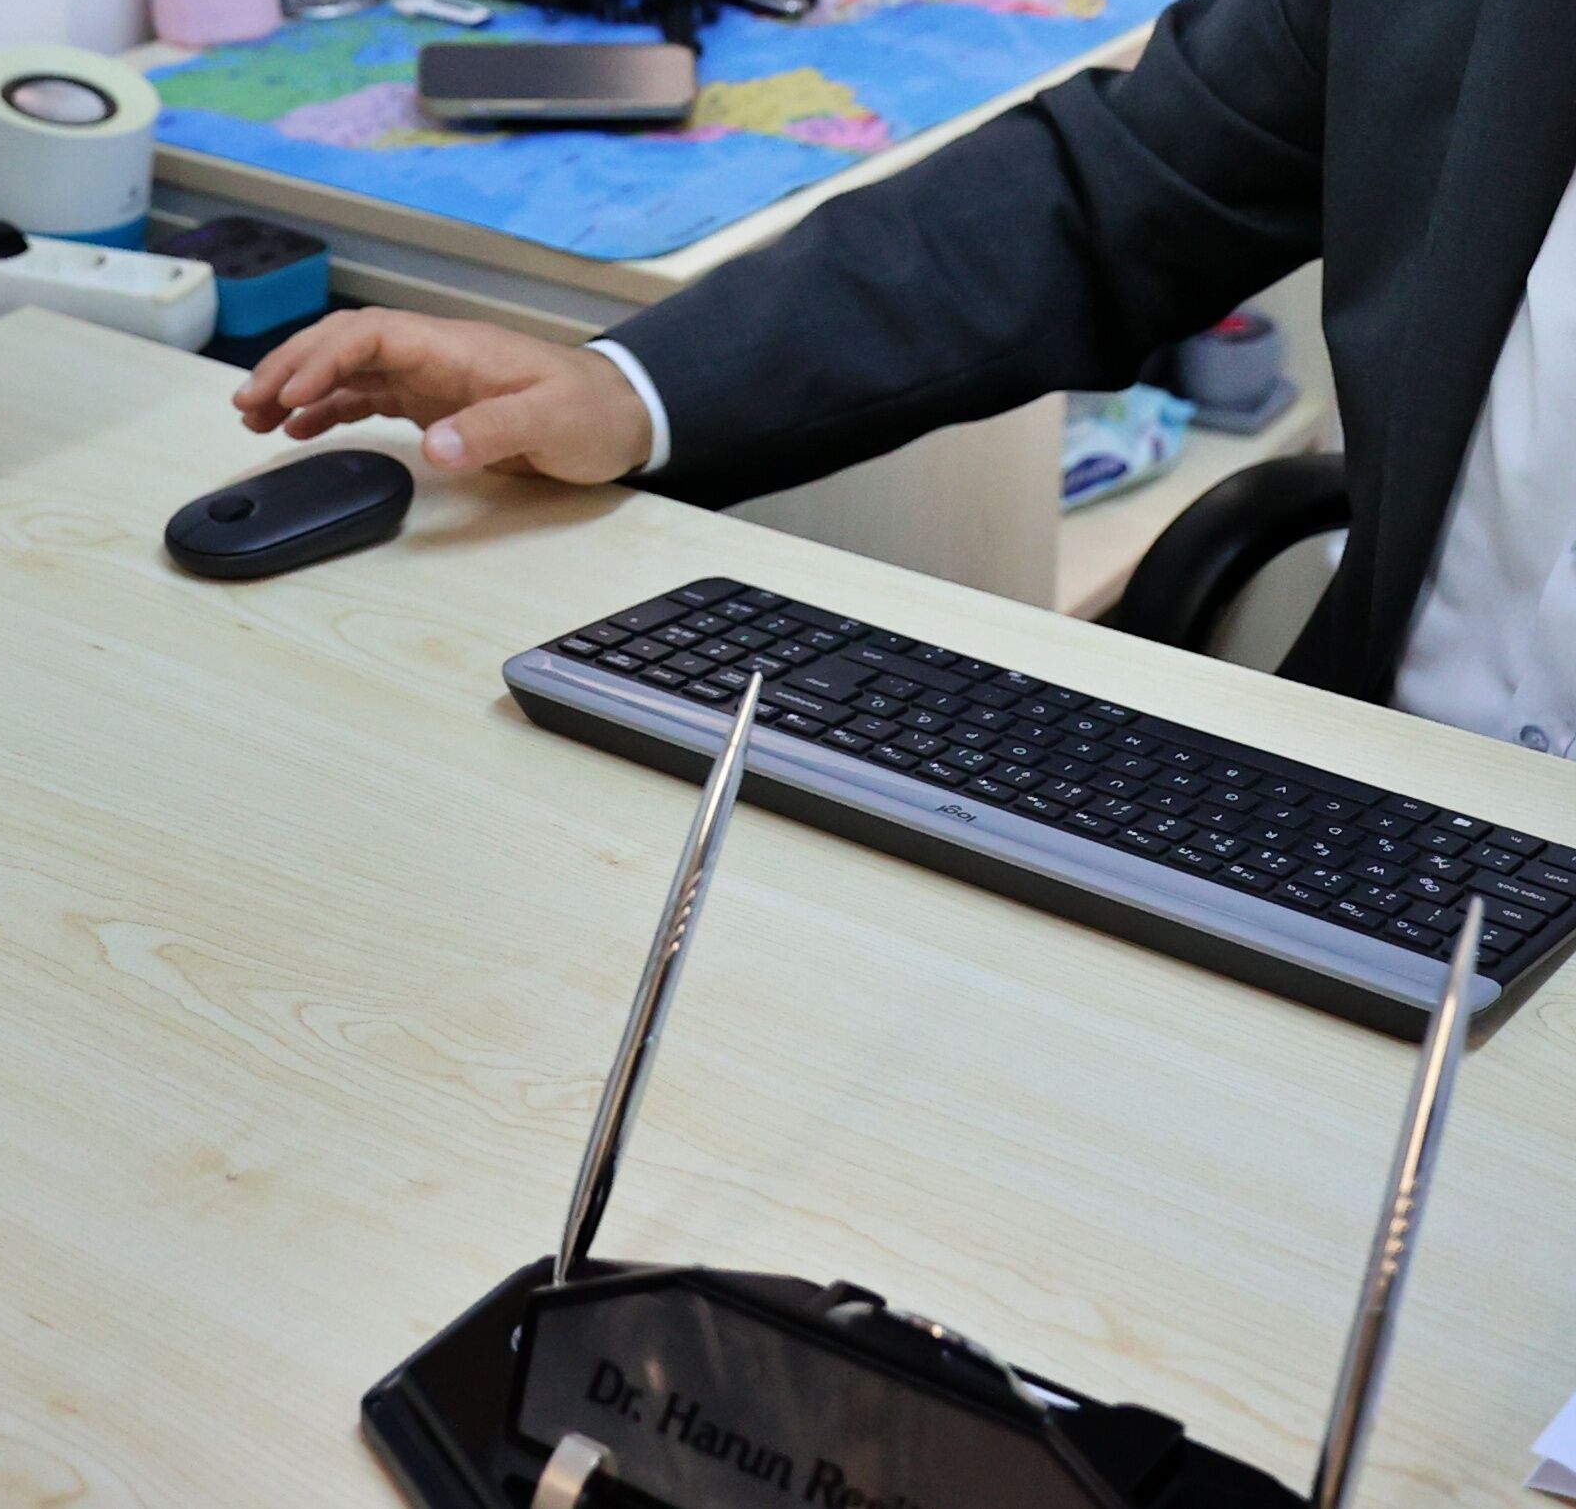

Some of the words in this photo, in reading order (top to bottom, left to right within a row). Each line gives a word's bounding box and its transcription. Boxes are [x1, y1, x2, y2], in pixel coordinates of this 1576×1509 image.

[1032, 727, 1042, 737] L
[1125, 735, 1141, 746] M
[1077, 743, 1090, 753] K
[1174, 752, 1190, 761] N
[1109, 779, 1125, 788] U
[1173, 775, 1189, 785] H
[1274, 785, 1288, 794] V
[1160, 796, 1173, 805] Y
[1326, 801, 1341, 810] C
[934, 804, 977, 824] logi
[1211, 812, 1224, 821] T
[1379, 818, 1393, 828] X
[1265, 830, 1278, 839] R
[1328, 827, 1342, 835] D
[1431, 836, 1446, 845] Z
[1366, 864, 1385, 875] W
[1543, 872, 1569, 884] shift
[1496, 881, 1519, 894] lock
[1519, 890, 1546, 903] caps
[1502, 909, 1522, 920] tab
[586, 1358, 642, 1423] Dr.
[656, 1392, 795, 1493] Harun
